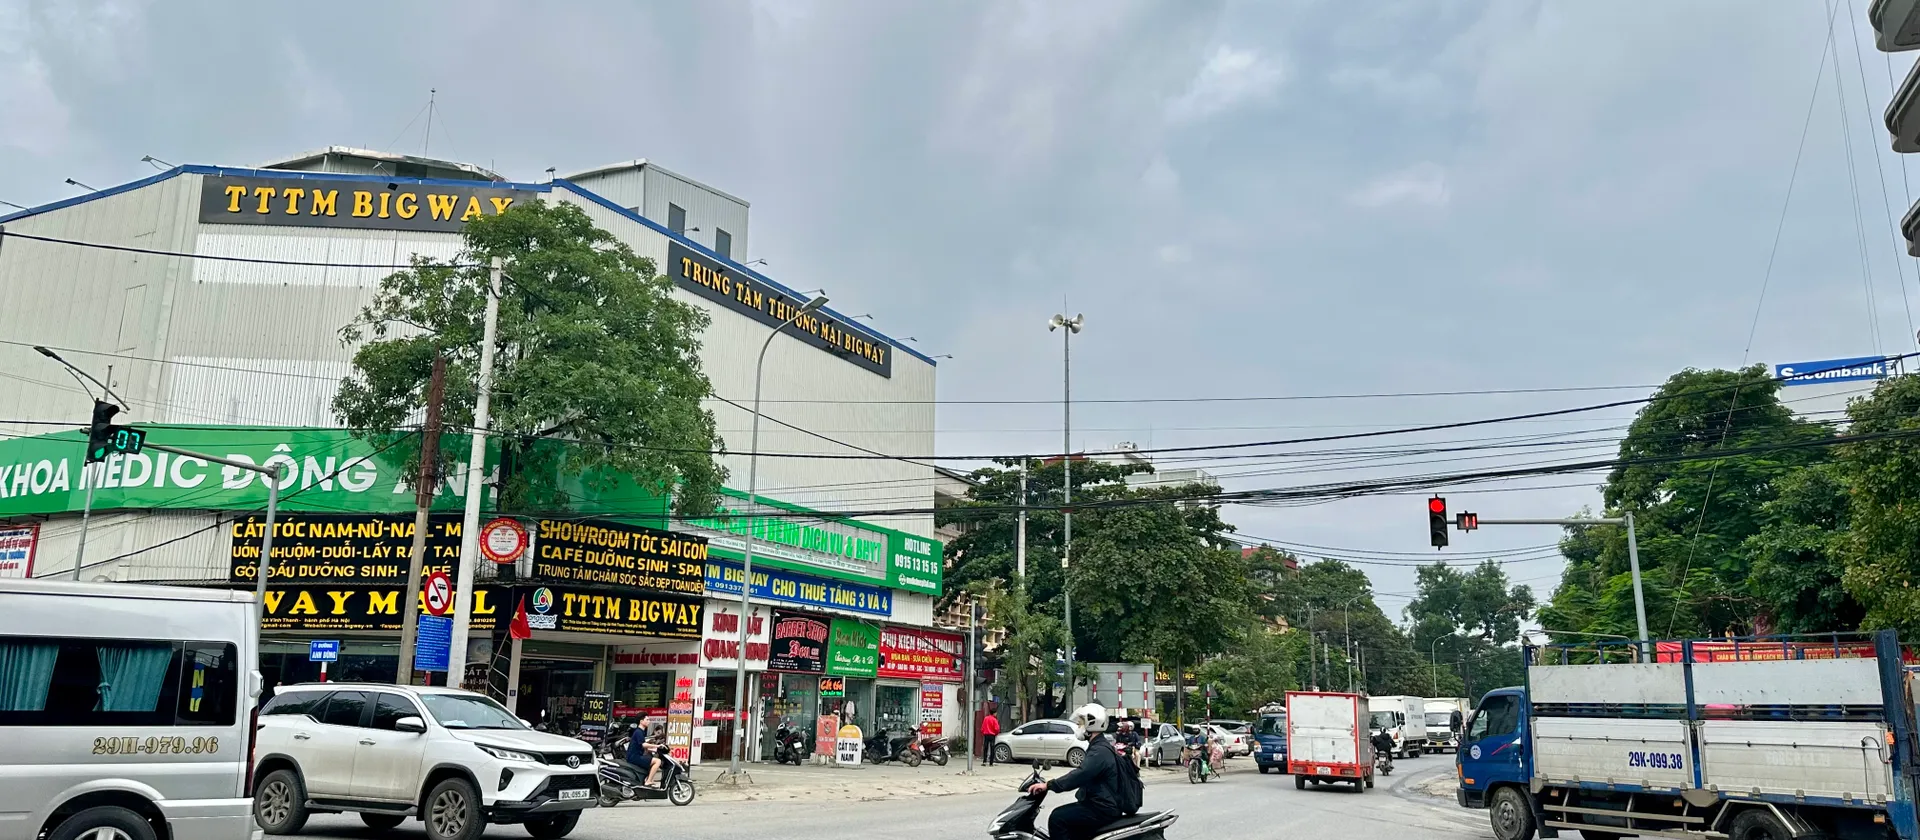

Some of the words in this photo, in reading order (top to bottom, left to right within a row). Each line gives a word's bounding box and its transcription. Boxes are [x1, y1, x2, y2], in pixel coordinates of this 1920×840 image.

[224, 185, 339, 217] TTTM
[352, 191, 514, 222] BIGWAY
[682, 257, 731, 295] TRUNG
[735, 278, 763, 311] TÂM
[768, 297, 818, 335] THƯƠNG
[821, 322, 842, 349] MẠI
[844, 333, 885, 365] BIGWAY
[115, 429, 140, 450] 07
[78, 452, 209, 491] MEDIC
[221, 444, 378, 493] ĐÔNG
[232, 517, 267, 538] CẮT
[539, 519, 630, 550] SHOWROOM
[632, 529, 657, 554] TÓC
[661, 534, 681, 558] SÀI
[682, 536, 708, 561] GÒN
[802, 526, 830, 556] DỊCH
[830, 532, 844, 560] VỤ
[844, 535, 853, 558] &
[855, 538, 882, 564] BHYT
[904, 537, 931, 556] HOTLINE
[299, 561, 355, 577] DƯỠNG
[360, 565, 398, 578] SINH
[421, 561, 451, 577] AFÉ
[541, 545, 583, 562] CAFÉ
[585, 550, 635, 570] DƯỠNG
[637, 558, 669, 573] SINH
[679, 563, 703, 577] SPA
[895, 553, 911, 570] 0915
[912, 557, 921, 571] 13
[922, 560, 930, 573] 15
[930, 561, 938, 575] 15
[538, 563, 571, 579] TRUNG
[572, 565, 593, 581] TÂM
[592, 567, 617, 582] CHĂM
[618, 571, 637, 585] SÓC
[638, 571, 656, 587] SẮC
[655, 578, 671, 592] ĐẸP
[772, 578, 796, 598] CHO
[799, 582, 827, 603] THUÊ
[829, 583, 857, 605] TẦNG
[858, 594, 866, 608] 3
[867, 591, 882, 610] VÀ
[881, 597, 889, 612] 4
[562, 593, 621, 620] TTTM
[628, 599, 701, 626] BIGWAY
[775, 621, 806, 640] BARBER
[806, 619, 828, 643] SHOP
[881, 632, 897, 651] PHỤ
[898, 633, 915, 652] KIỆN
[588, 699, 604, 710] TÓC
[92, 736, 219, 755] 29H-979.96
[667, 735, 688, 746] NAM
[840, 752, 854, 762] NAM
[1628, 751, 1683, 770] 29K-099.38
